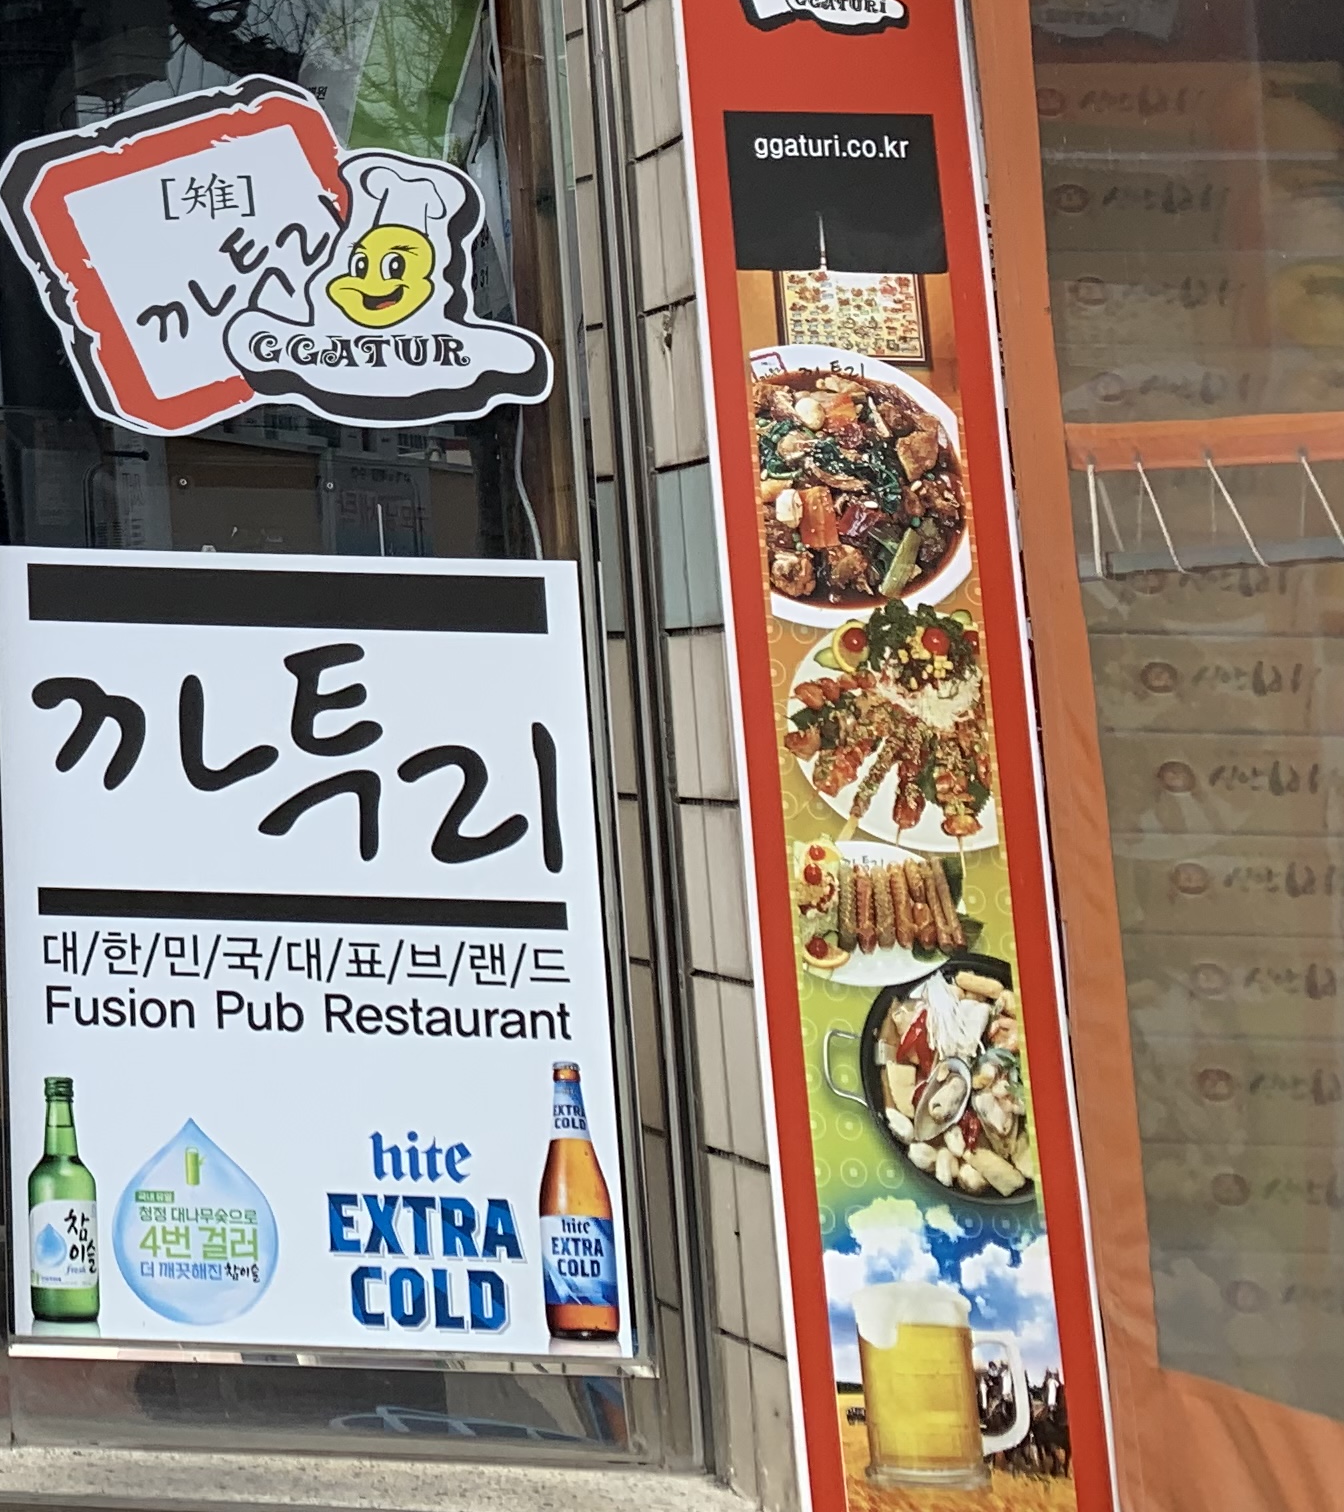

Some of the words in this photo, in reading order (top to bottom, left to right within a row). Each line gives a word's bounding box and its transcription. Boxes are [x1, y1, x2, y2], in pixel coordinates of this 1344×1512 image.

[754, 135, 909, 159] ggaturi.co.kr
[31, 642, 564, 874] 까투리
[45, 985, 196, 1030] Fusion
[215, 990, 305, 1033] Pub
[324, 993, 572, 1041] Restaurant
[553, 1104, 587, 1118] EXTRA
[554, 1117, 587, 1130] COLD
[369, 1131, 472, 1183] hite
[139, 1206, 167, 1222] 청정
[326, 1192, 528, 1263] EXTRA
[561, 1219, 590, 1234] hite
[139, 1225, 191, 1259] 4번
[198, 1226, 258, 1262] 걸러
[552, 1236, 605, 1257] EXTRA
[140, 1261, 154, 1278] 더
[159, 1262, 223, 1280] 깨끗해진
[224, 1262, 261, 1283] 참이슬
[557, 1258, 601, 1278] COLD
[351, 1265, 511, 1334] COLD
